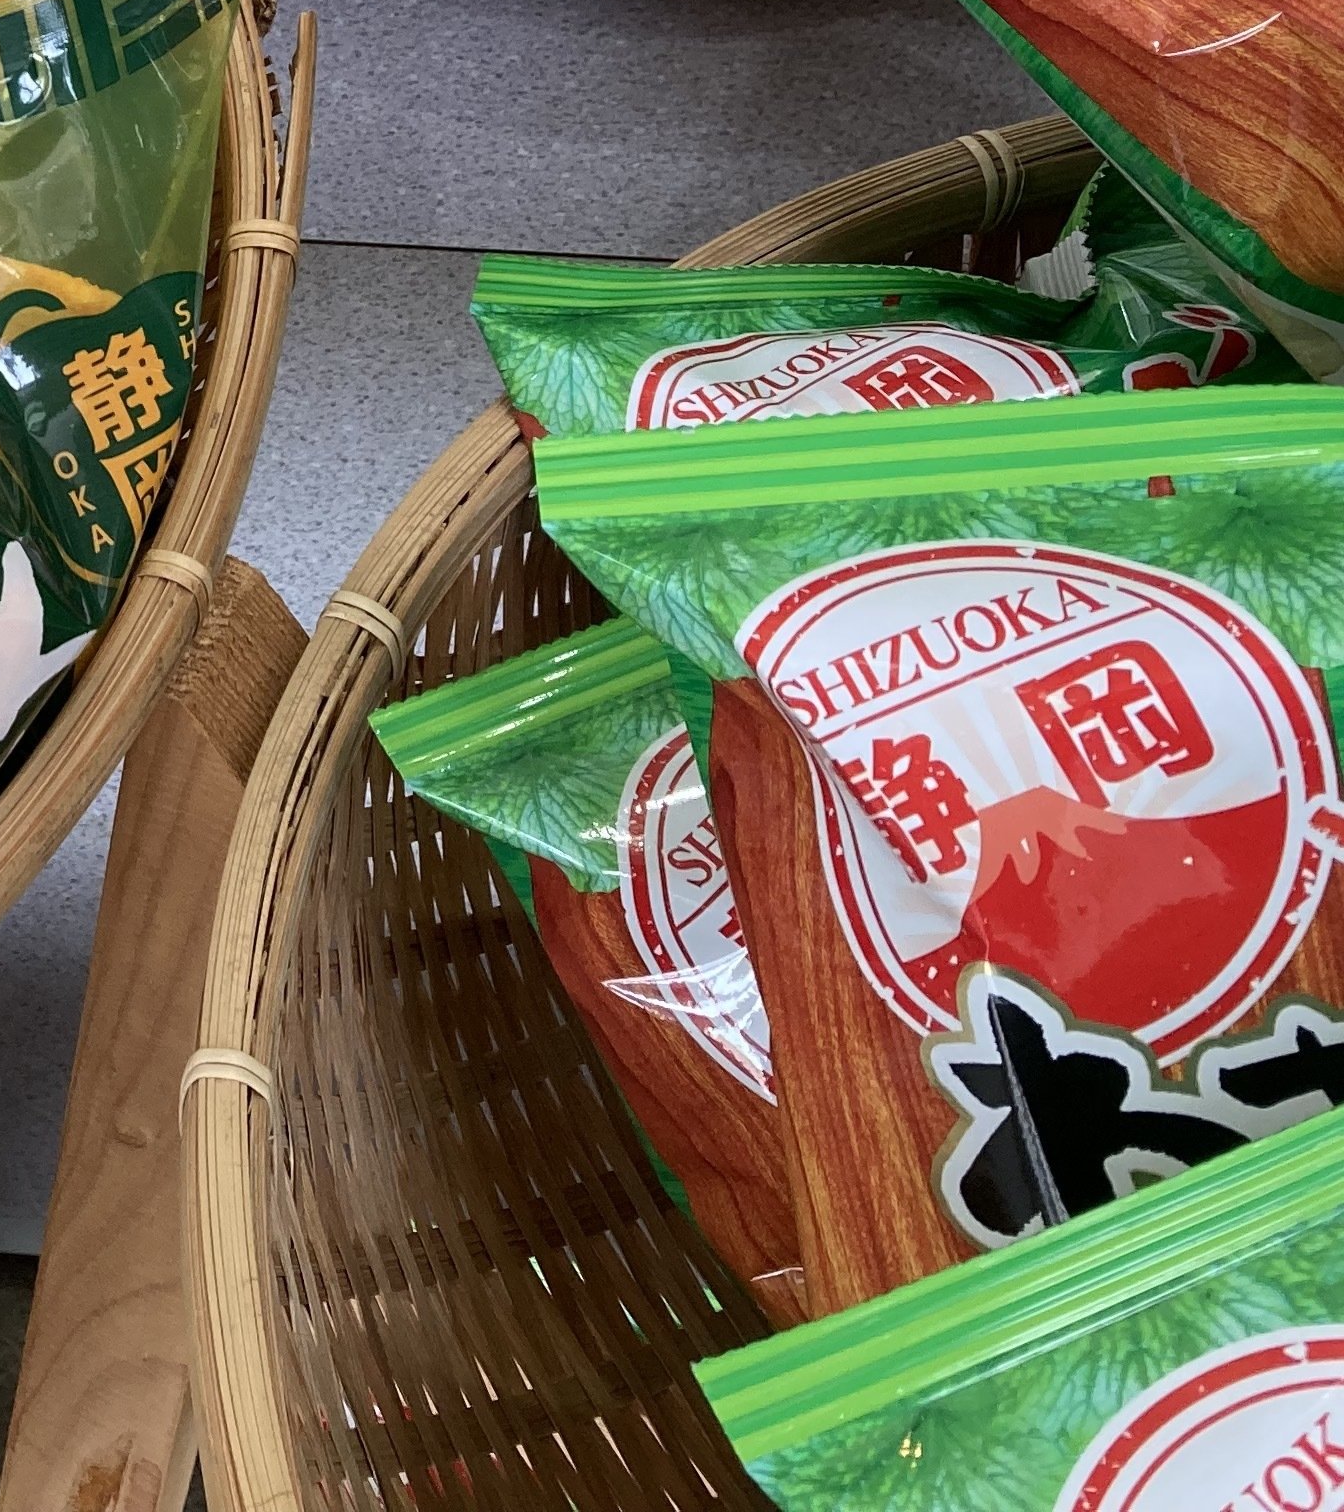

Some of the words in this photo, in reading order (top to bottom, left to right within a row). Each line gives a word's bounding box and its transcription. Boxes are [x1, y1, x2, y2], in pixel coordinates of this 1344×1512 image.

[672, 326, 890, 428] SHIZUOKA
[53, 450, 116, 555] OKA
[776, 574, 1110, 730] SHIZUOKA
[838, 657, 1218, 885] 静岡
